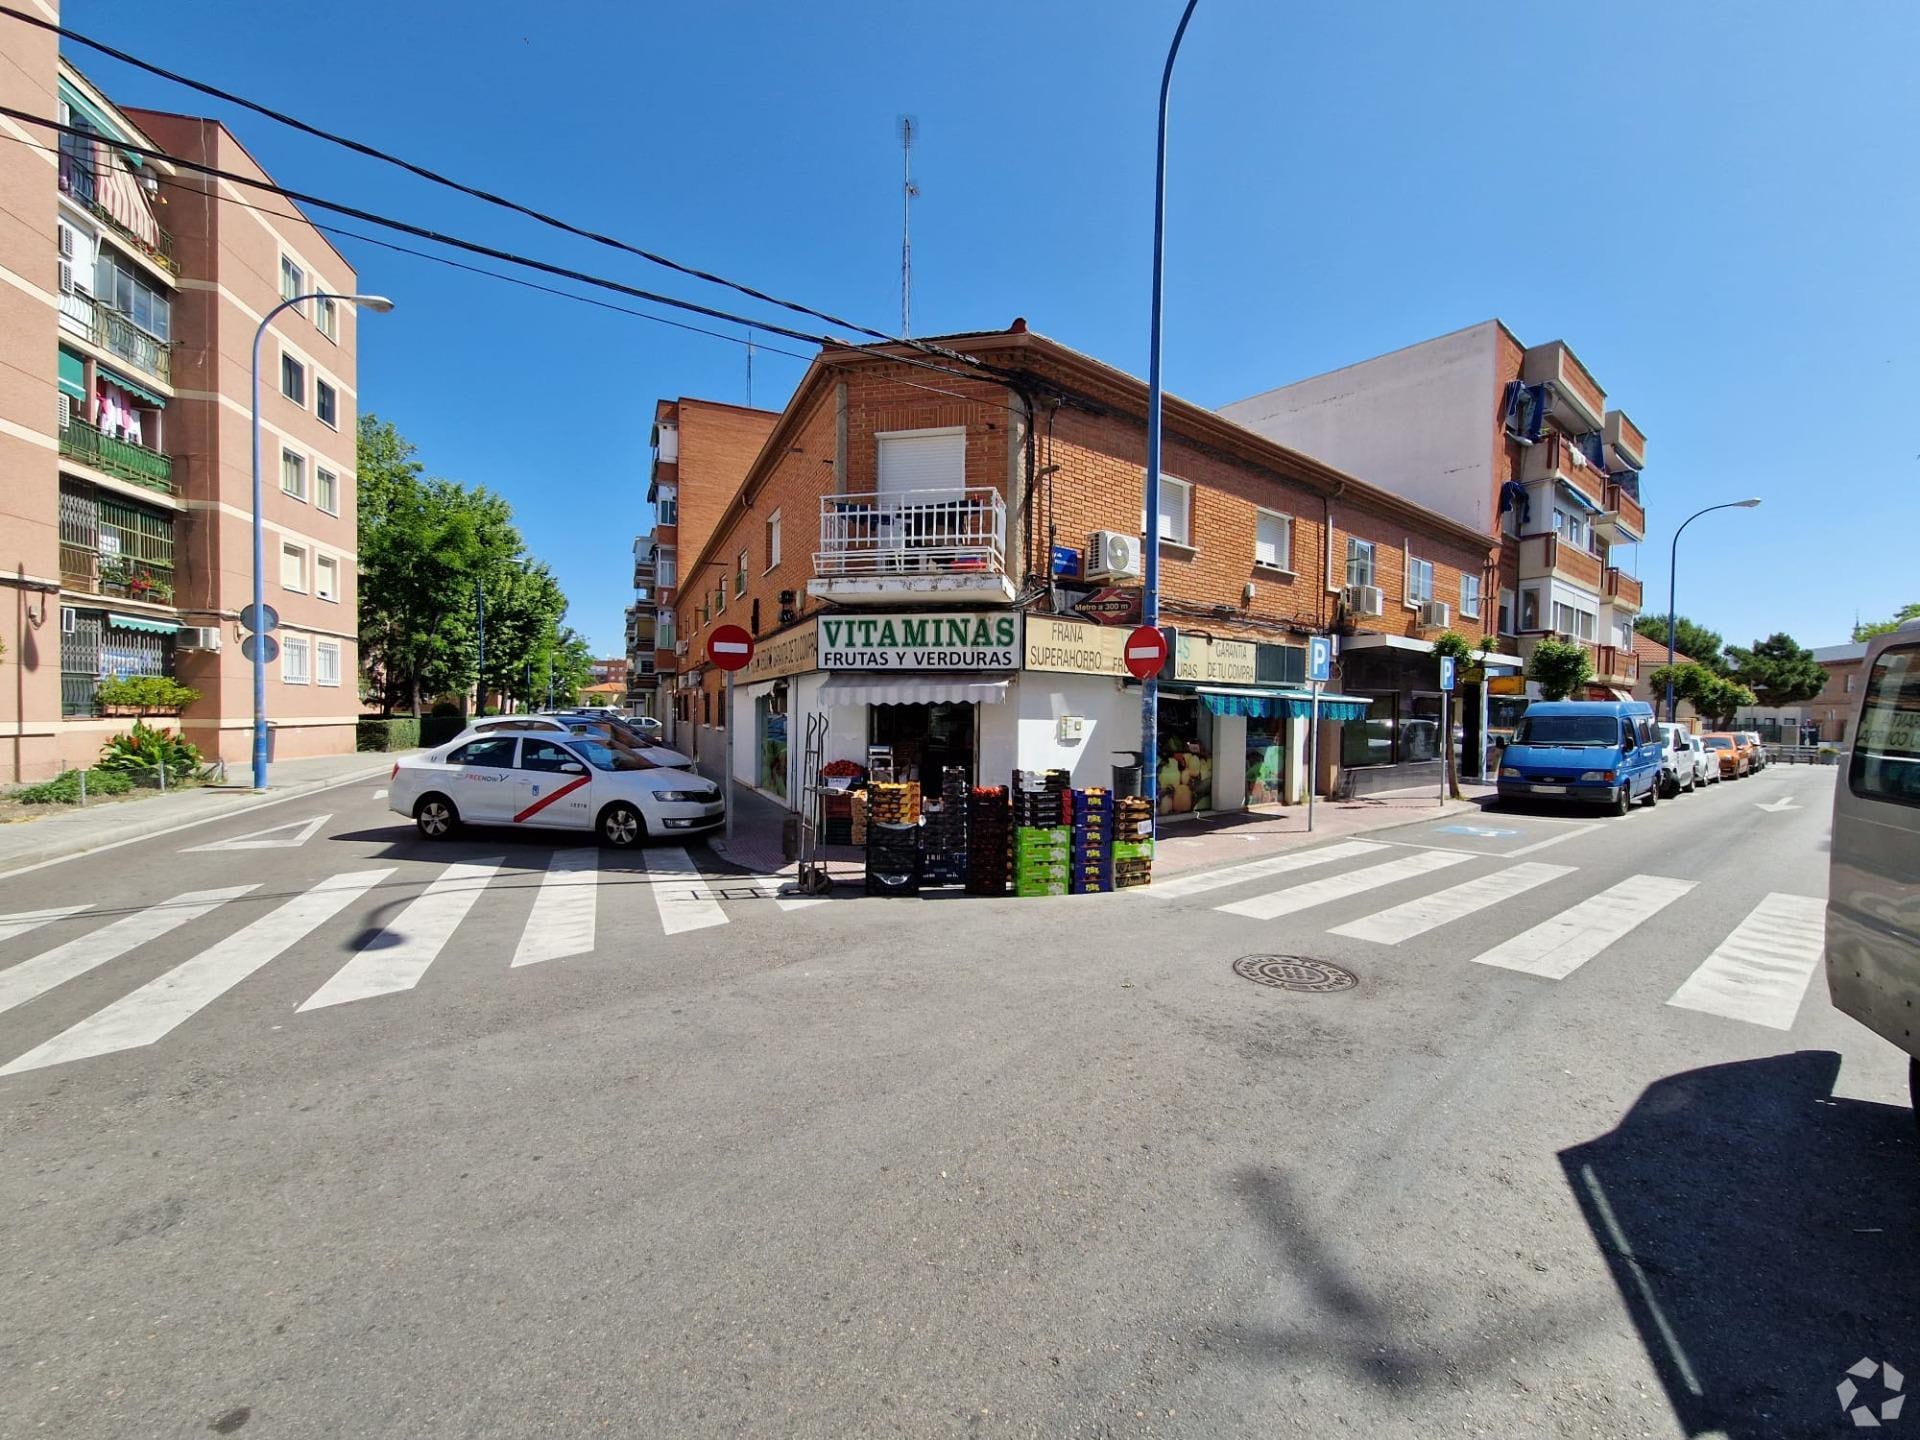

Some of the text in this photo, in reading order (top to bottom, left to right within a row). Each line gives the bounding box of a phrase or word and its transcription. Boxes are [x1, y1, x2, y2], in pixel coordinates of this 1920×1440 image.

[1075, 603, 1096, 611] Metro
[823, 617, 1015, 648] VITAMINAS
[1052, 622, 1083, 643] FRANA
[824, 651, 1012, 666] FRUTAS Y VERDURAS
[1031, 646, 1102, 670] SUPERAHORRO
[1113, 657, 1198, 678] FRU URAS
[1313, 643, 1326, 674] P
[1208, 662, 1253, 680] DE TU COMPRA
[1444, 660, 1452, 686] P
